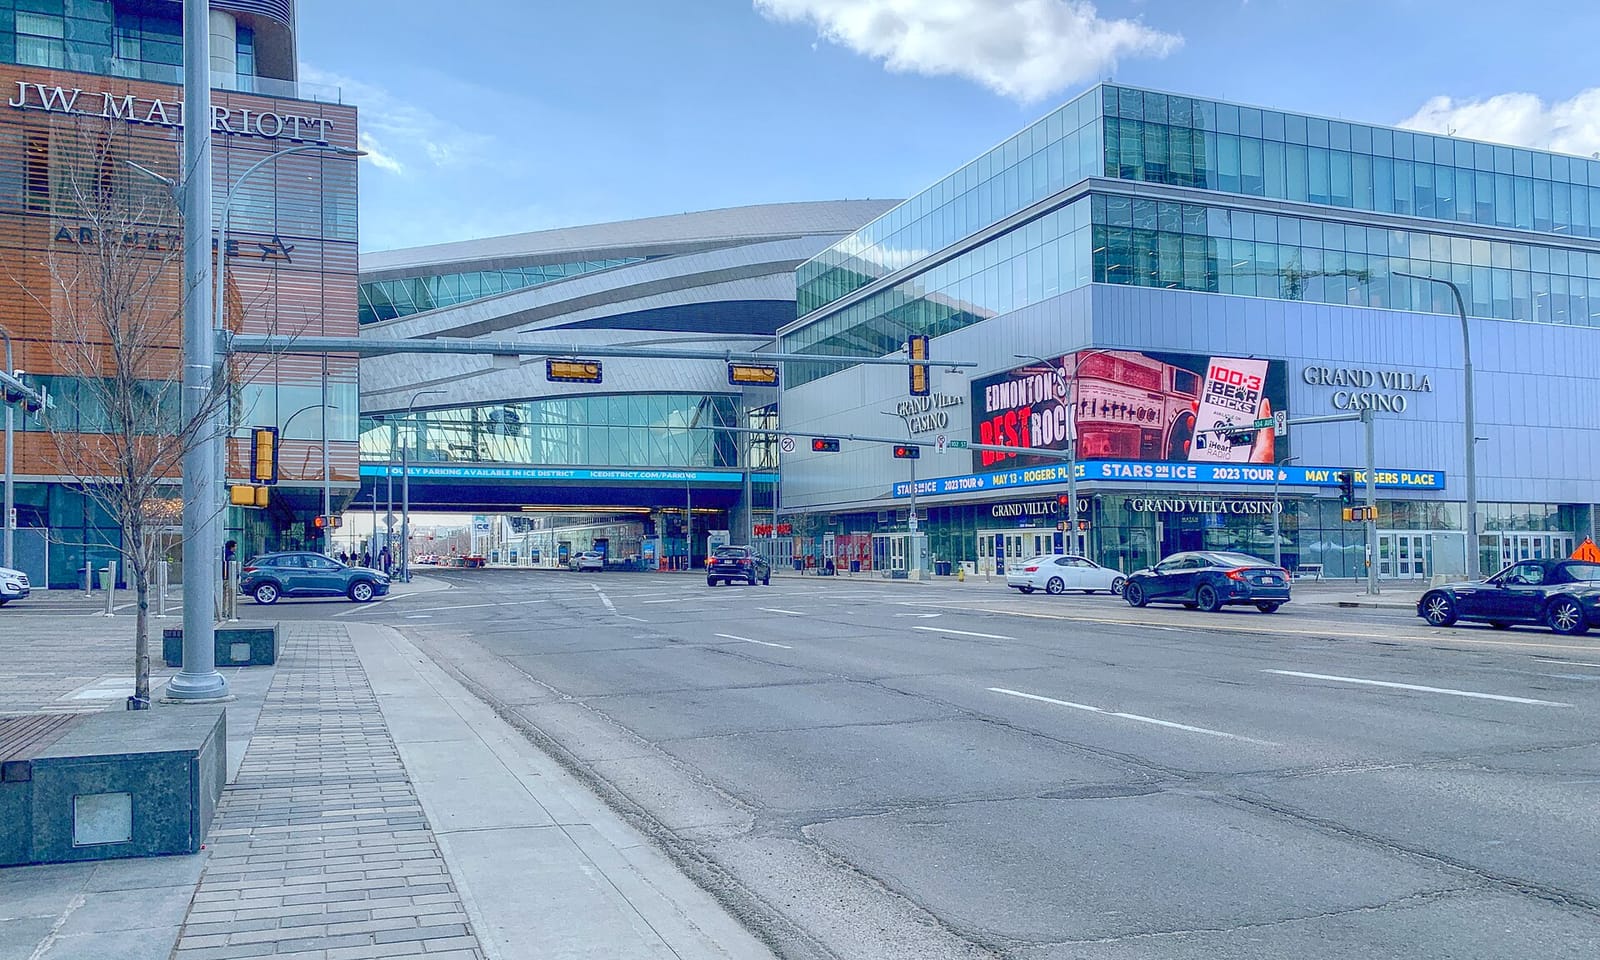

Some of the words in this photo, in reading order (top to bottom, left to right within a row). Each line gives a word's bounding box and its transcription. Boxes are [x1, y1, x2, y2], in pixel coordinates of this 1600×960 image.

[98, 92, 334, 142] MARIOTT
[985, 367, 1066, 412] EDMONTON'S
[1303, 366, 1375, 388] GRAND
[1378, 371, 1432, 392] VILLA
[896, 396, 931, 416] GRAND
[932, 391, 963, 408] VILLA
[1208, 395, 1253, 413] ROCKS
[1332, 390, 1408, 413] CASINO
[909, 411, 948, 434] CASINO
[980, 406, 1031, 467] BEST
[1031, 404, 1078, 447] ROCK
[1208, 441, 1232, 453] iHeart
[1206, 449, 1232, 460] RADIO
[423, 467, 461, 475] PARKING
[463, 468, 510, 476] AVAILABLE
[590, 471, 697, 479] ICEDISTRICT.COM/PARKING
[925, 481, 937, 492] ICE
[944, 479, 959, 491] 2023
[959, 477, 977, 489] TOUR
[992, 473, 1008, 486] MAY
[1009, 473, 1018, 484] 13
[1024, 468, 1056, 482] ROGERS
[1057, 465, 1086, 478] PLCE
[1102, 463, 1153, 477] STARS
[1155, 465, 1169, 473] ON
[1172, 467, 1197, 479] ICE
[1213, 468, 1240, 480] 2023
[1242, 468, 1274, 481] TOUR
[1305, 470, 1329, 482] MAY
[1401, 474, 1436, 485] PLACE
[992, 503, 1022, 517] GRAND
[1022, 502, 1048, 515] VILLA
[1132, 499, 1185, 513] GRAND
[1188, 500, 1229, 513] VILLA
[1230, 501, 1283, 514] CASINO
